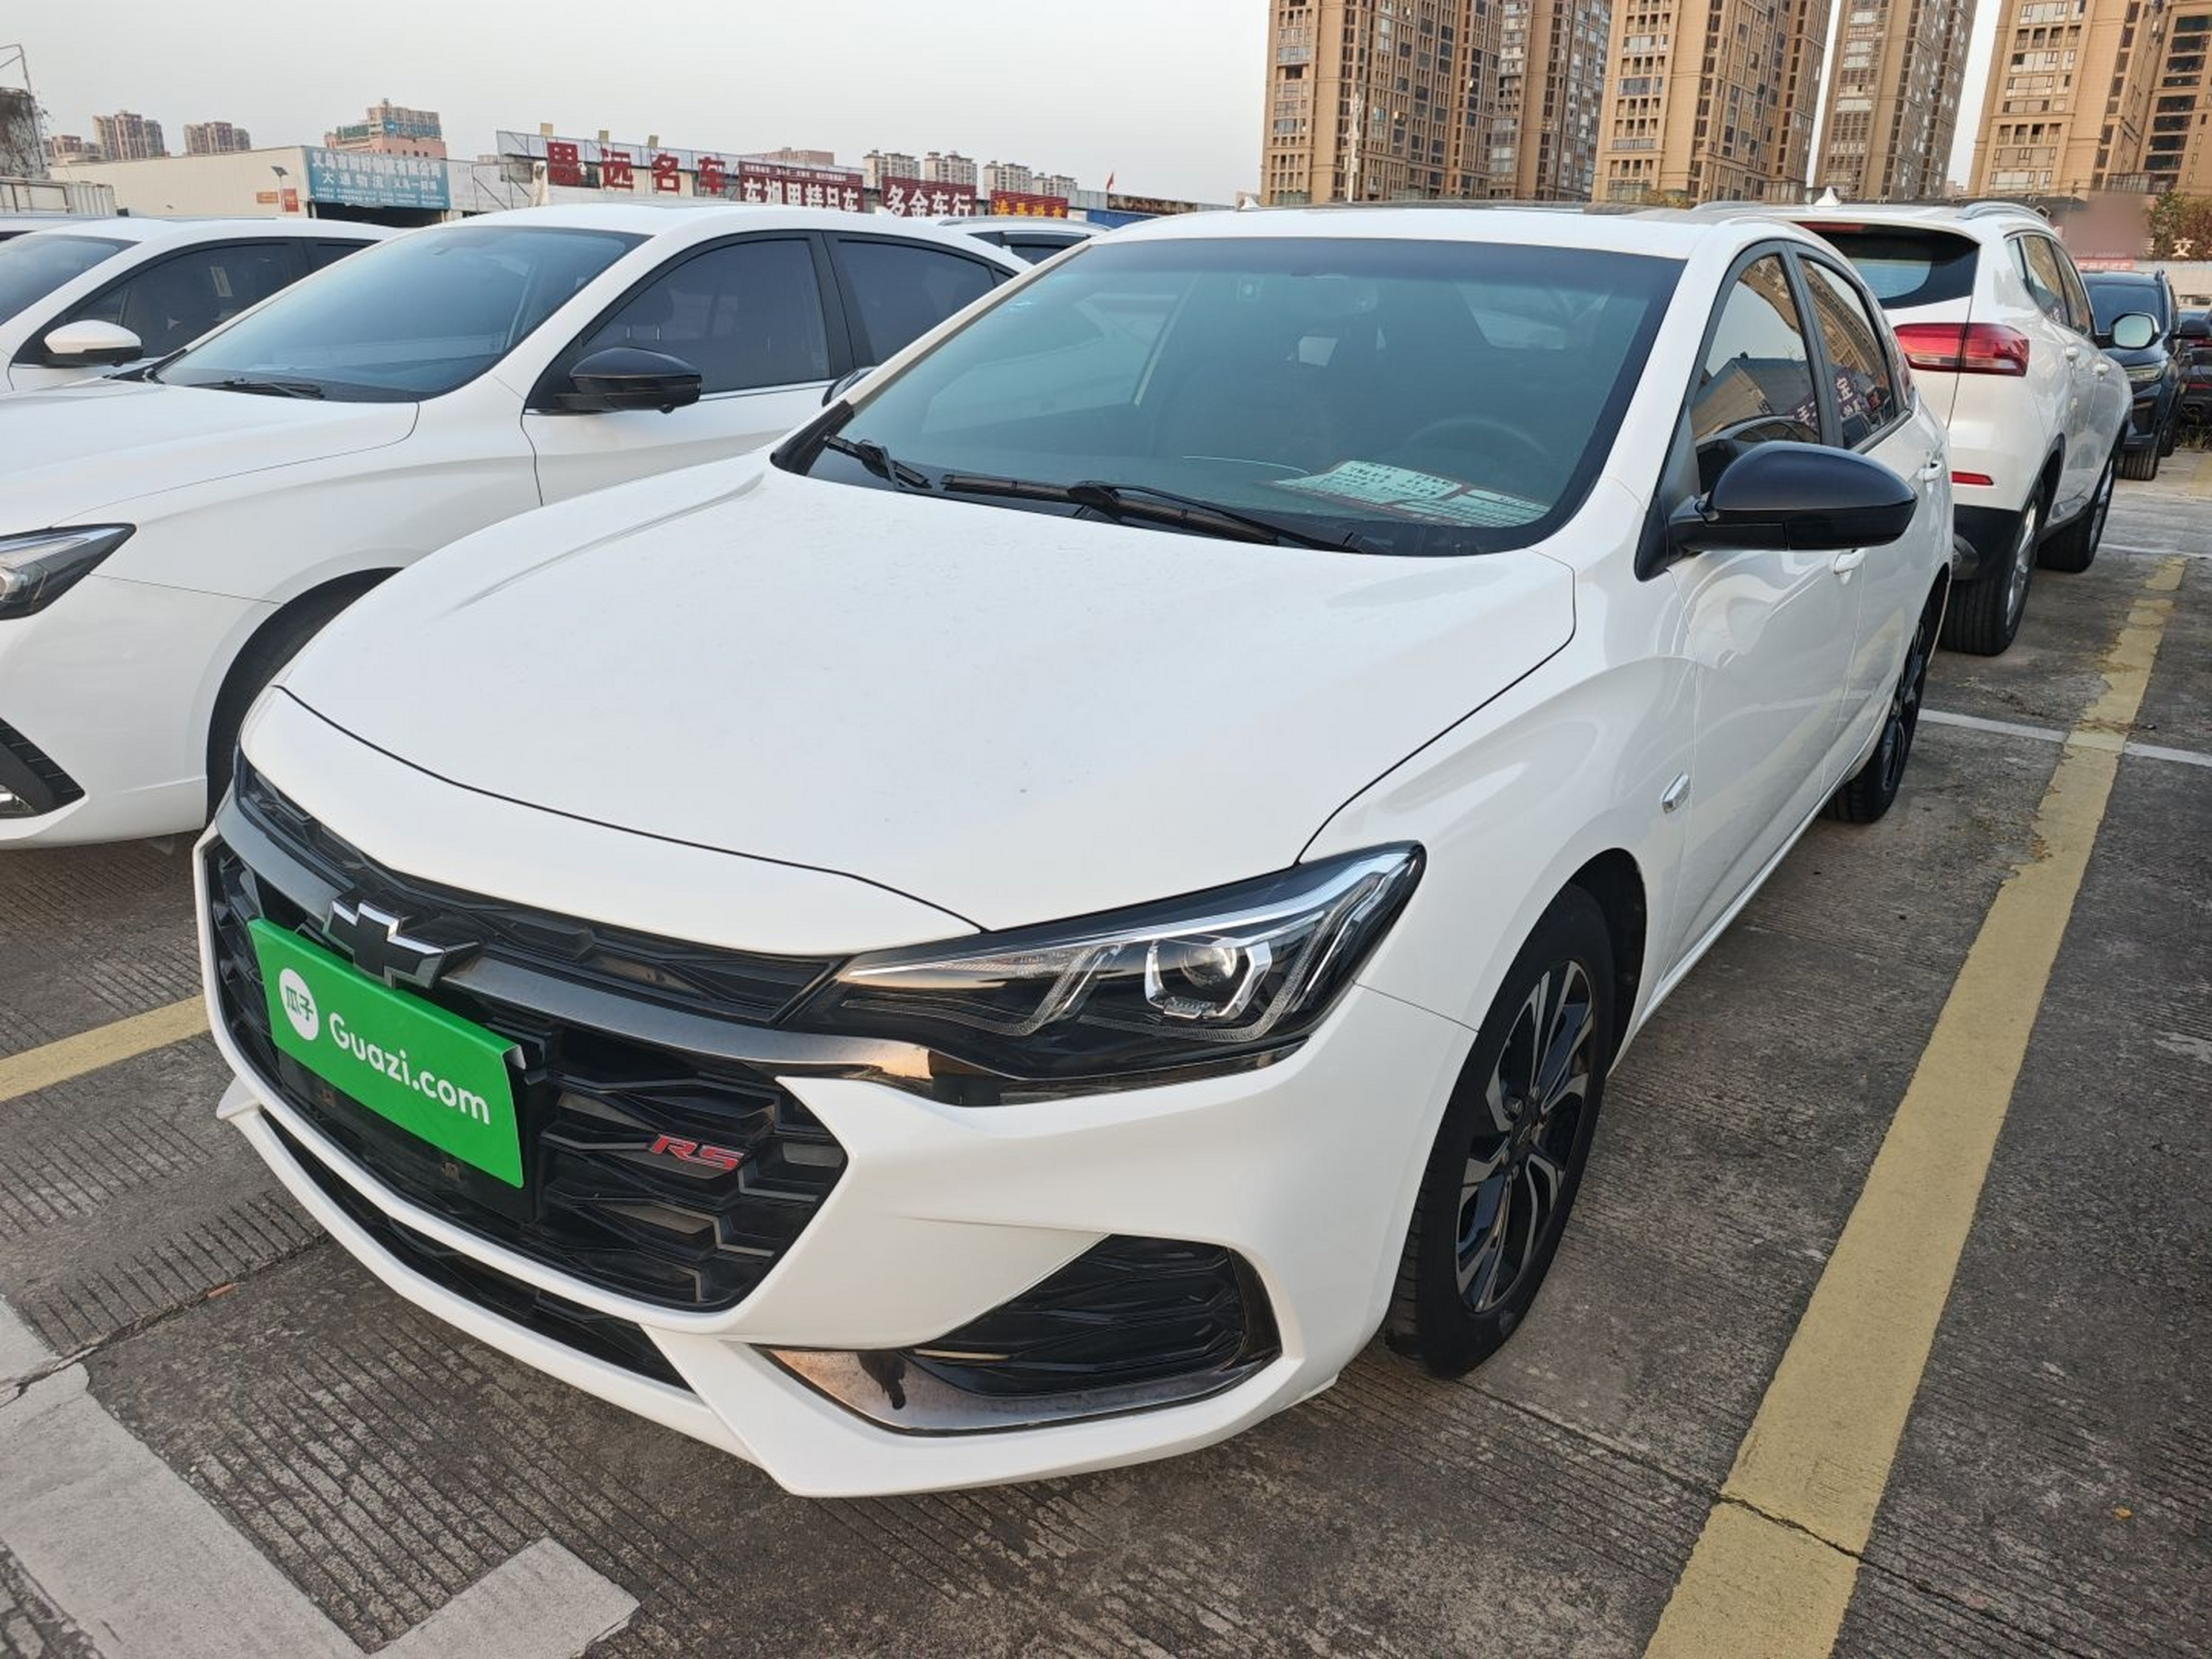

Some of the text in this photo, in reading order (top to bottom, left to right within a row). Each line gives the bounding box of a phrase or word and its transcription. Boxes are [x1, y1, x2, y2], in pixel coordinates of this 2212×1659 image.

[887, 184, 971, 217] 多金车行
[329, 1012, 490, 1124] Guazi.com
[650, 1133, 745, 1170] RS
